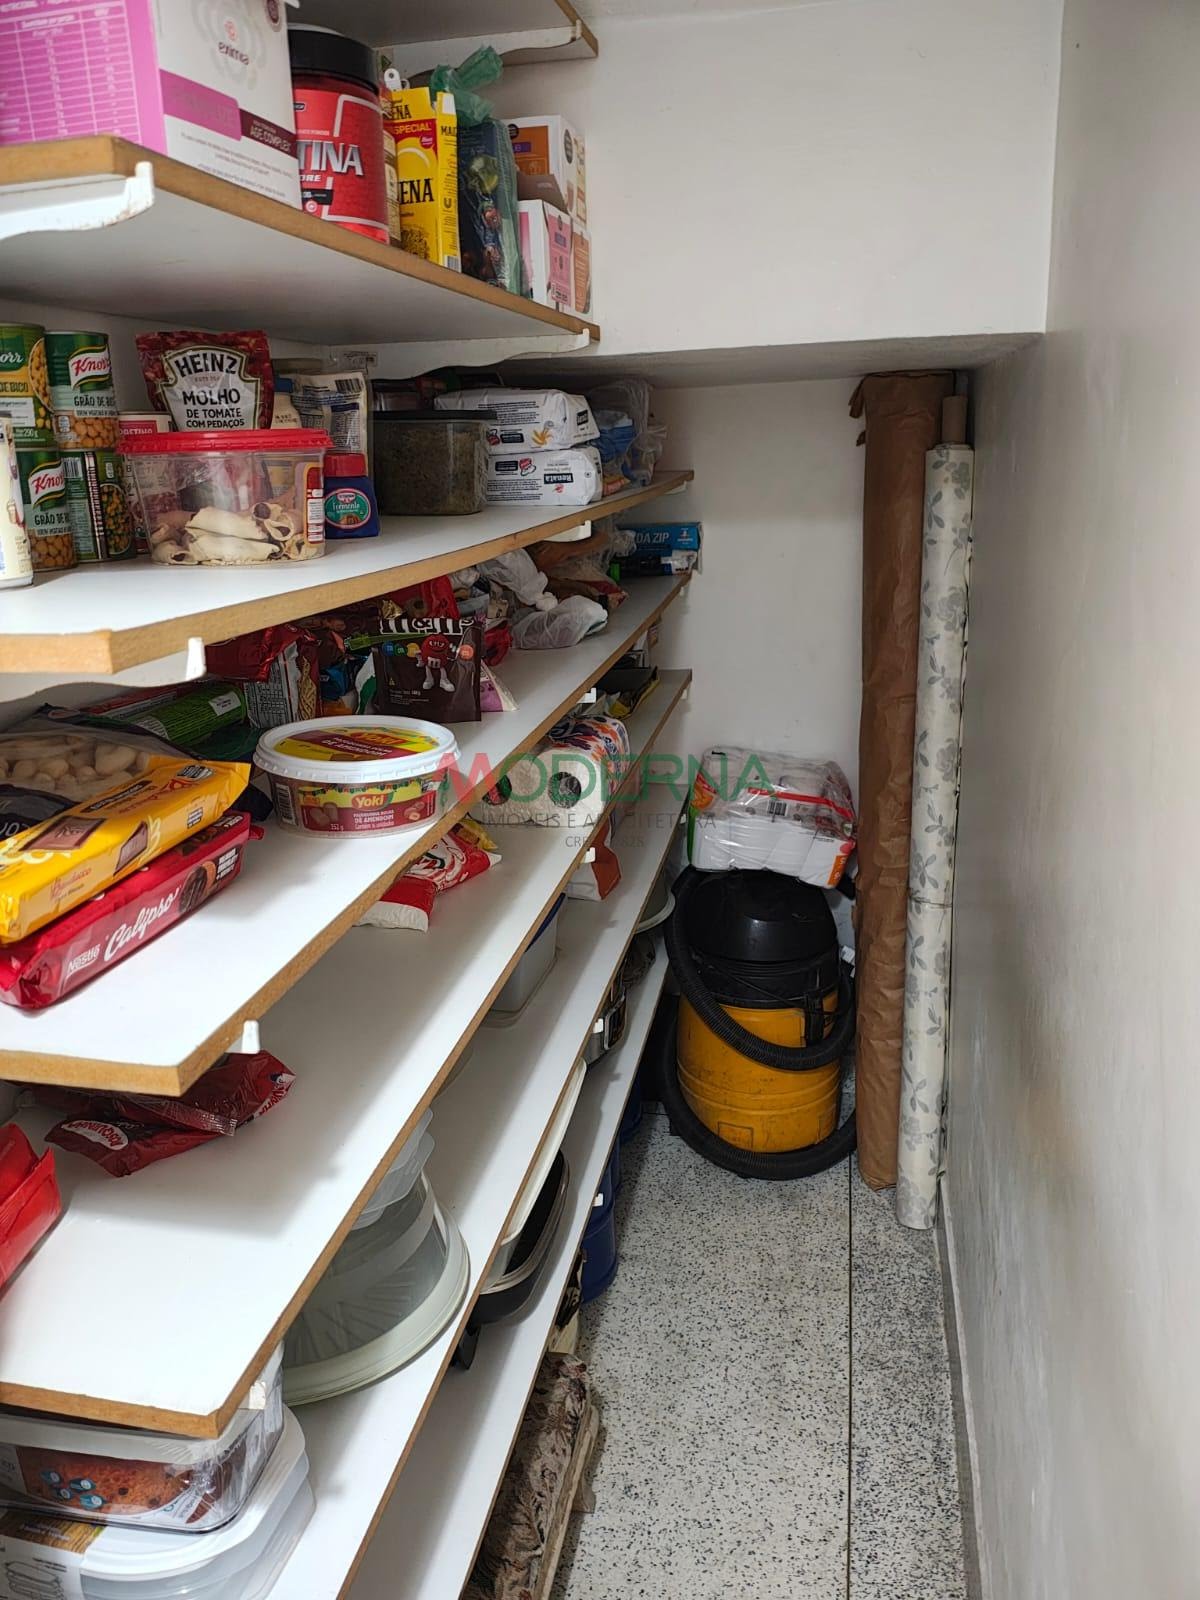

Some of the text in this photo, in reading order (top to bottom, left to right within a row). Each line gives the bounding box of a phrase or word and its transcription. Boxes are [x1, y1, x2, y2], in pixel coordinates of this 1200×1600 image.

[174, 352, 238, 377] HEINZ
[74, 394, 95, 406] GRÃO
[182, 388, 241, 405] MOLHO
[187, 407, 243, 419] DE TOMATE
[186, 418, 245, 429] COM PEDAÇOS
[34, 512, 55, 525] GRÃO
[652, 532, 670, 543] ZIP
[355, 795, 384, 809] Yoki
[104, 885, 181, 962] Calipso
[68, 943, 101, 974] Nestlé
